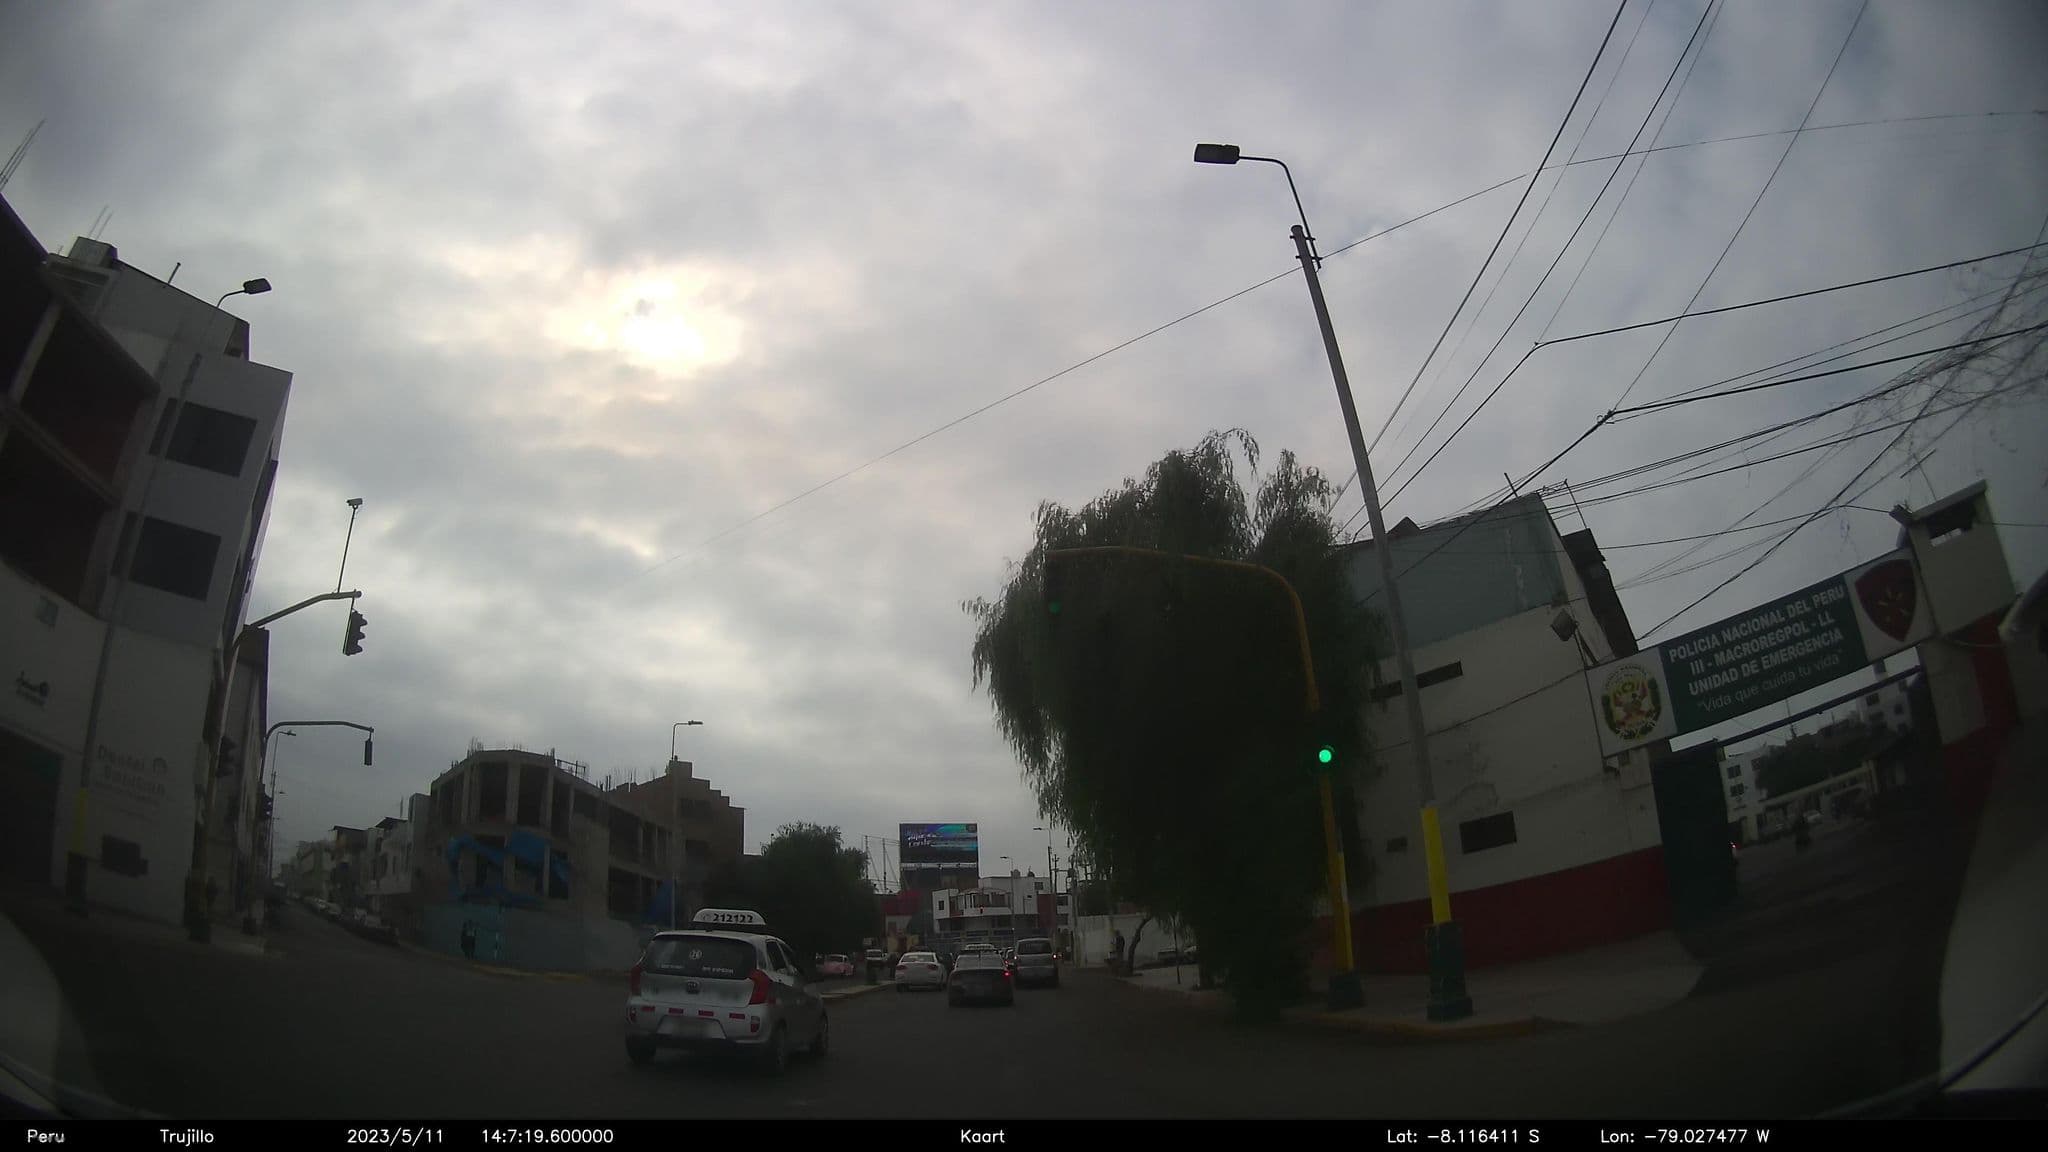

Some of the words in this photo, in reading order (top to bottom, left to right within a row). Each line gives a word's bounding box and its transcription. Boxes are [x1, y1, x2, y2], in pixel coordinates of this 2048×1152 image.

[1669, 633, 1721, 663] POLICIA
[1721, 610, 1786, 642] NACIONAL
[1786, 599, 1812, 619] DEL
[1812, 584, 1846, 608] PERU
[1690, 658, 1705, 675] III
[1714, 621, 1811, 667] MACROREGPOL
[1818, 612, 1835, 627] LL
[1688, 667, 1739, 696] UNIDAD
[1741, 659, 1761, 678] DE
[1761, 628, 1844, 670] EMERGENCIA
[1735, 685, 1761, 703] que
[1762, 670, 1796, 691] cuida
[1798, 664, 1813, 680] tu
